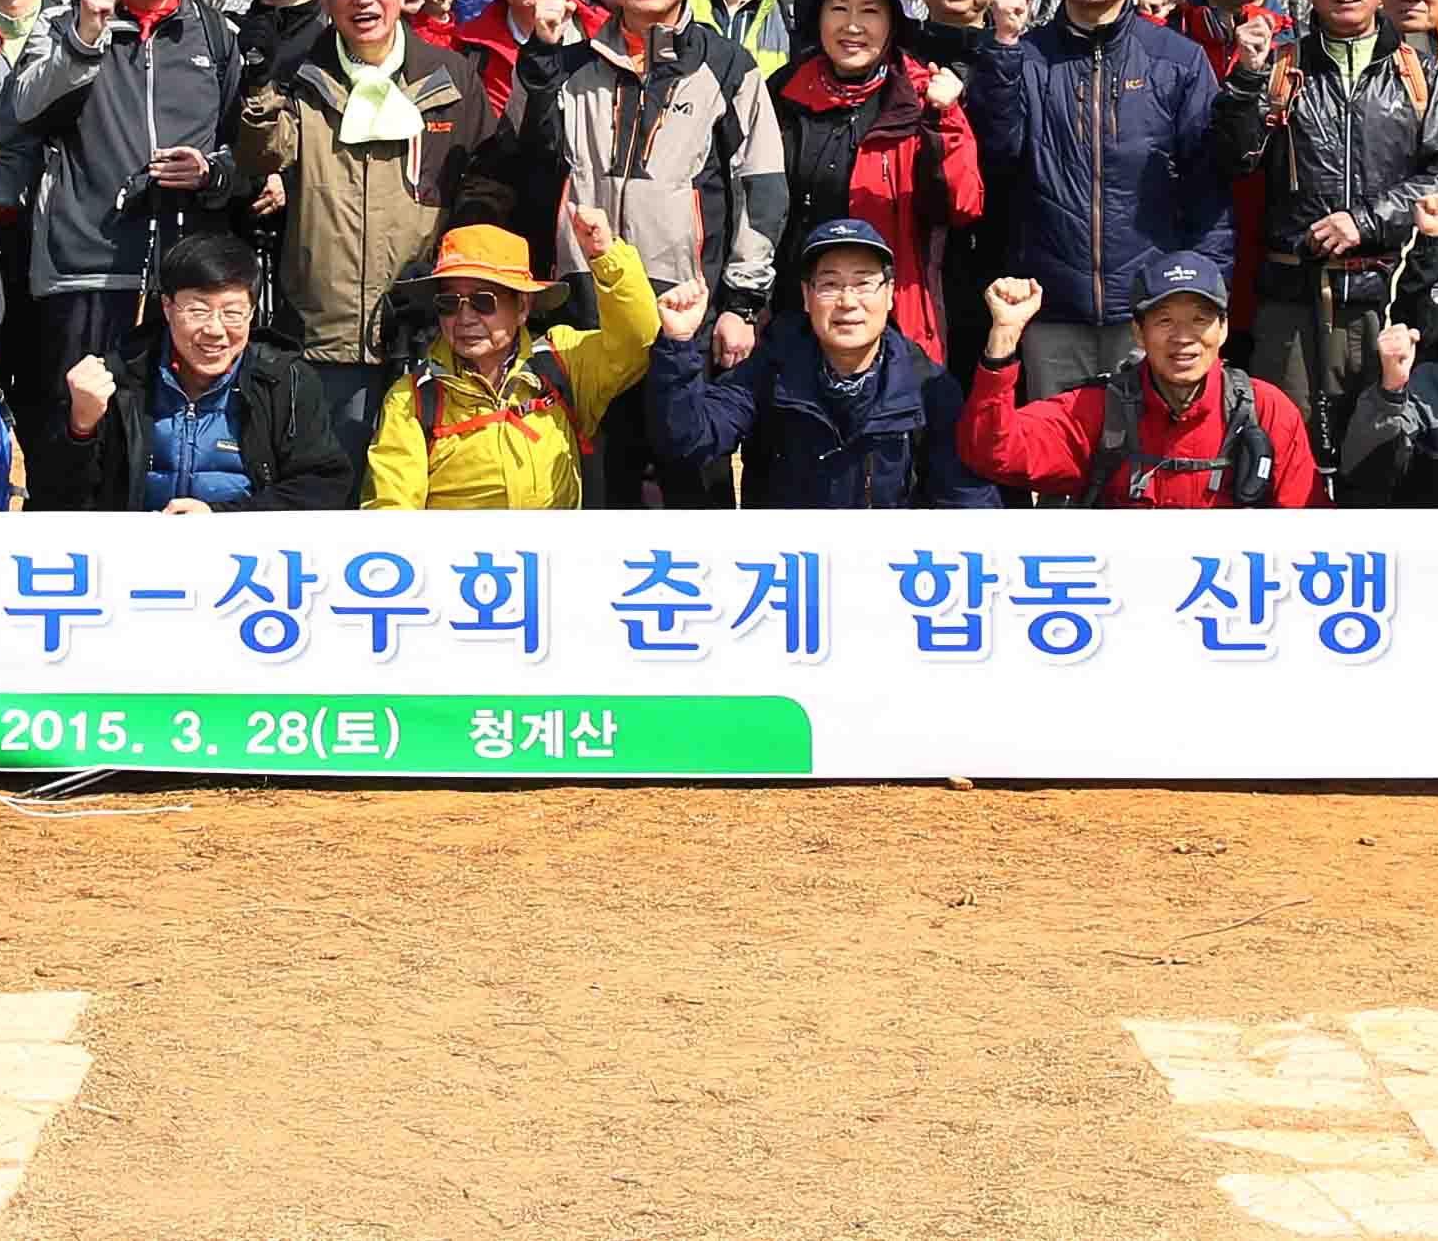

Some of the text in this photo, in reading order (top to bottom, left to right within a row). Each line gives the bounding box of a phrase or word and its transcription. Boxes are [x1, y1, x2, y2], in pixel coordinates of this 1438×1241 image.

[612, 549, 821, 654] 춘계
[890, 549, 1111, 655] 합동
[1179, 550, 1386, 654] 산행
[0, 706, 618, 760] 2015. 3. 28(토) 청계산
